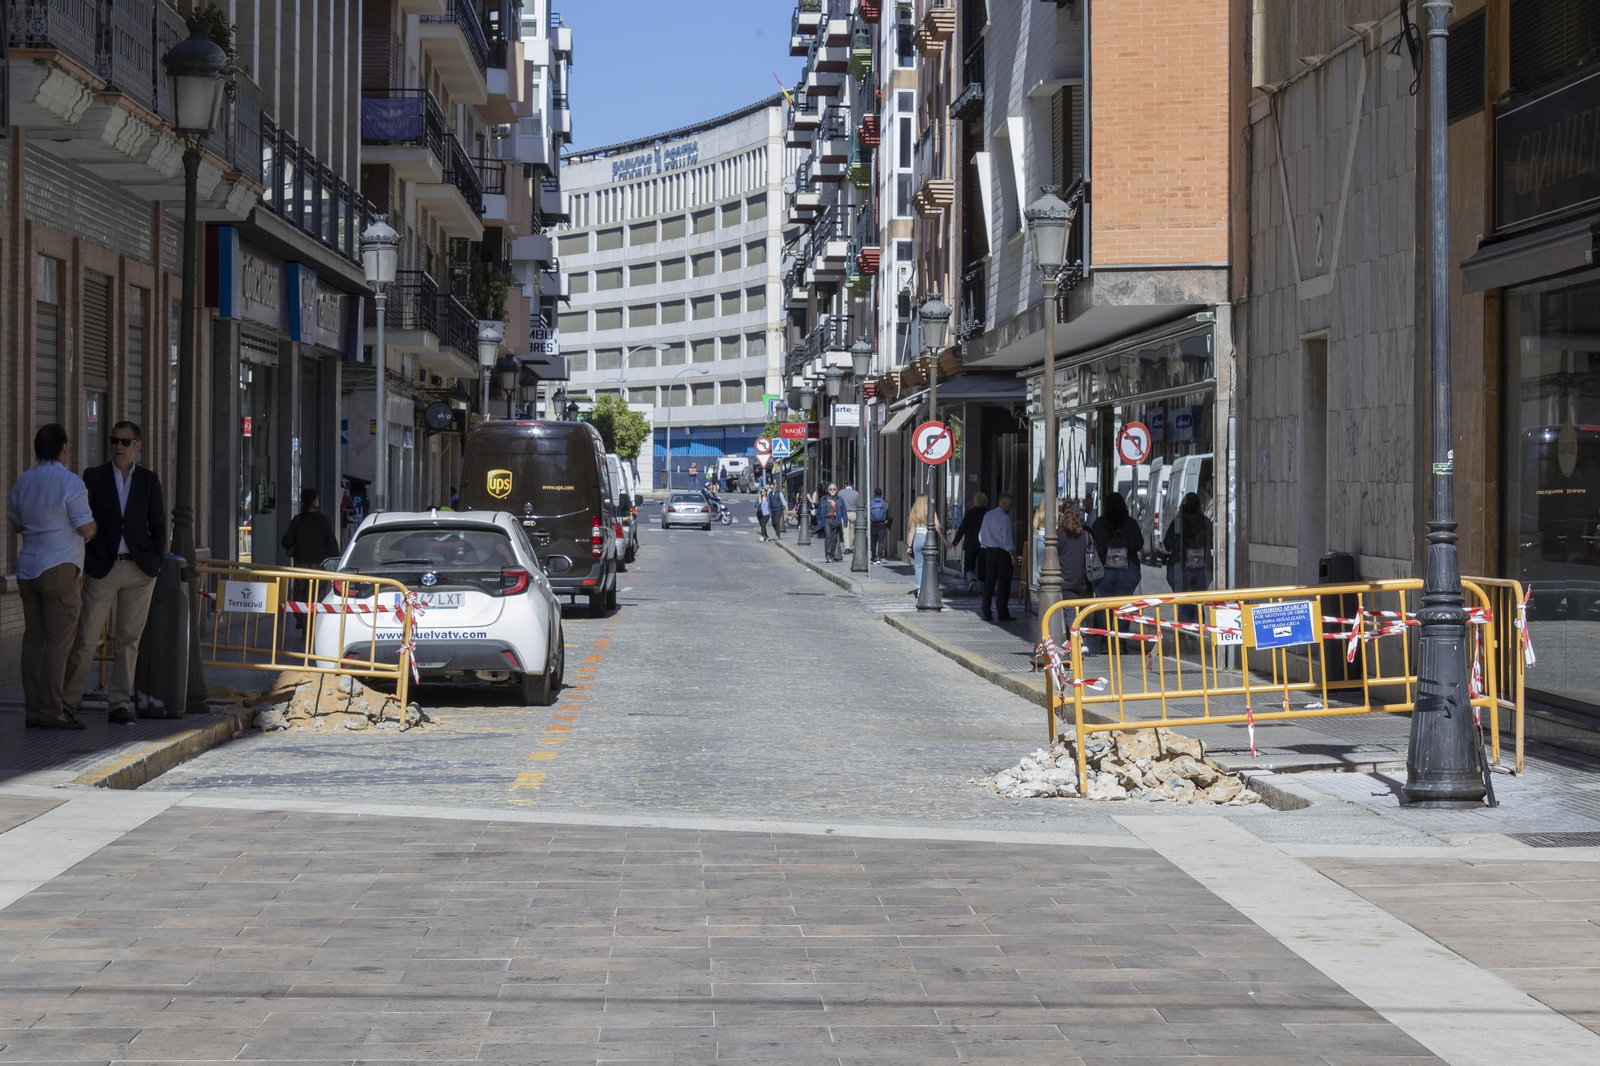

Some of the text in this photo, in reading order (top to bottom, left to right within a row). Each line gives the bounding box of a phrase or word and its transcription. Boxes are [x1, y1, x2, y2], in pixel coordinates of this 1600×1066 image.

[489, 478, 511, 494] ups
[228, 599, 263, 608] Terracivil
[438, 594, 462, 605] LXT
[1254, 603, 1308, 614] PROHIBIDO APARCAR
